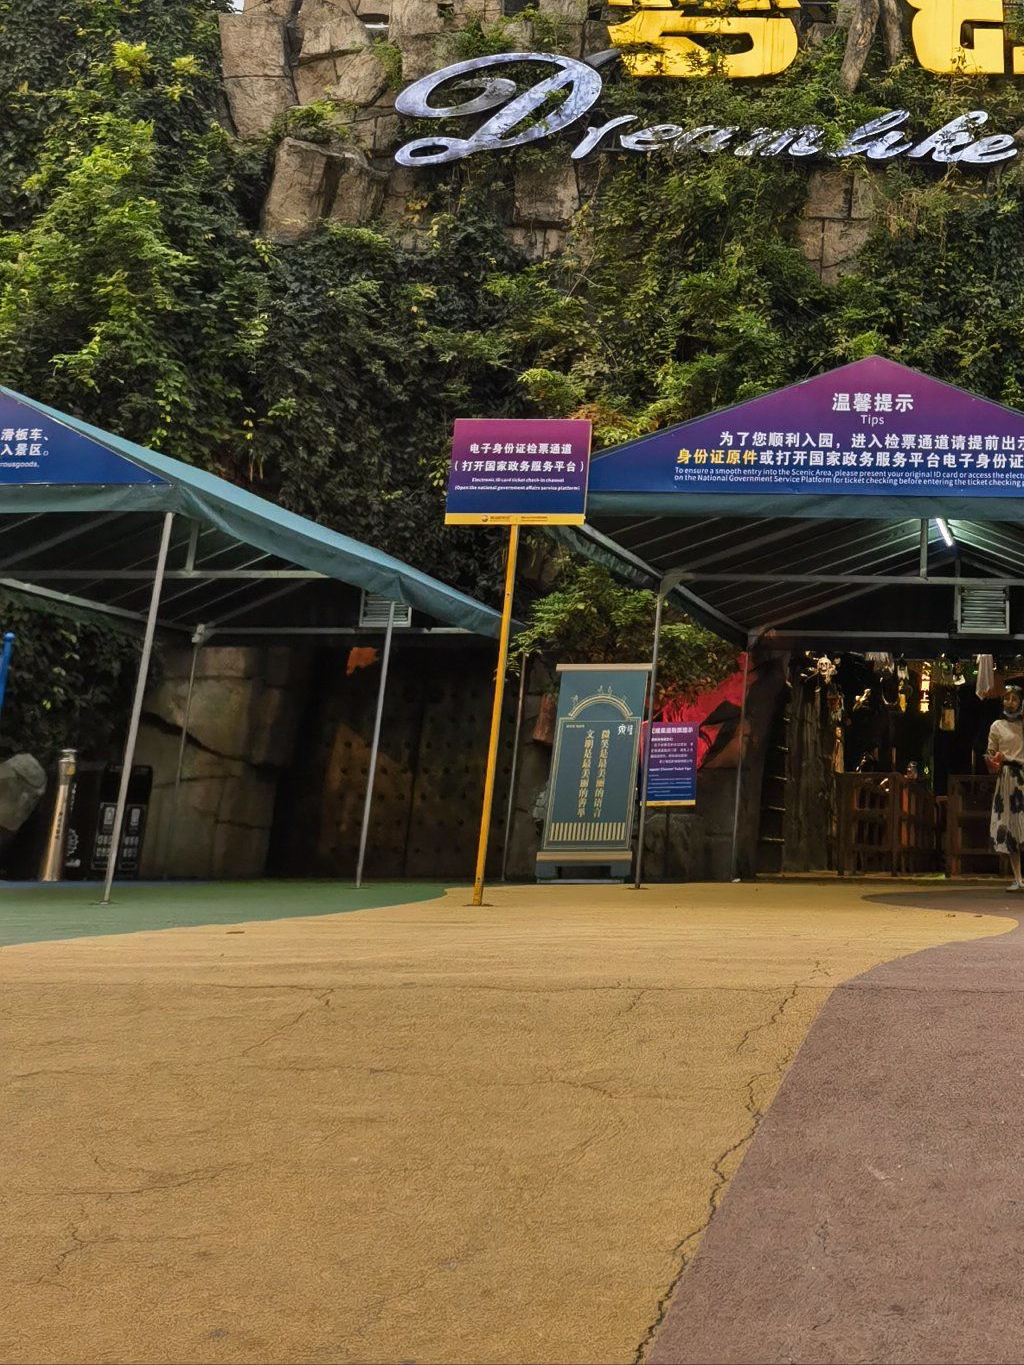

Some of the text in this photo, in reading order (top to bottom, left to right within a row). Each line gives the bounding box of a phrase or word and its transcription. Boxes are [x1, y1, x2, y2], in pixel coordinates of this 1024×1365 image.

[394, 51, 1019, 168] Dreamlike
[831, 392, 915, 413] 温馨提示
[860, 414, 885, 427] Tips
[1, 428, 49, 441] 滑板车、
[1, 443, 49, 456] 入景区。
[469, 443, 573, 455] 电子身份证检票通道
[743, 468, 762, 477] entry
[816, 469, 834, 478] Area,
[835, 469, 858, 478] please
[859, 470, 886, 478] present
[905, 470, 932, 479] original
[866, 477, 898, 485] checking
[923, 478, 954, 486] entering
[989, 479, 1021, 487] checking
